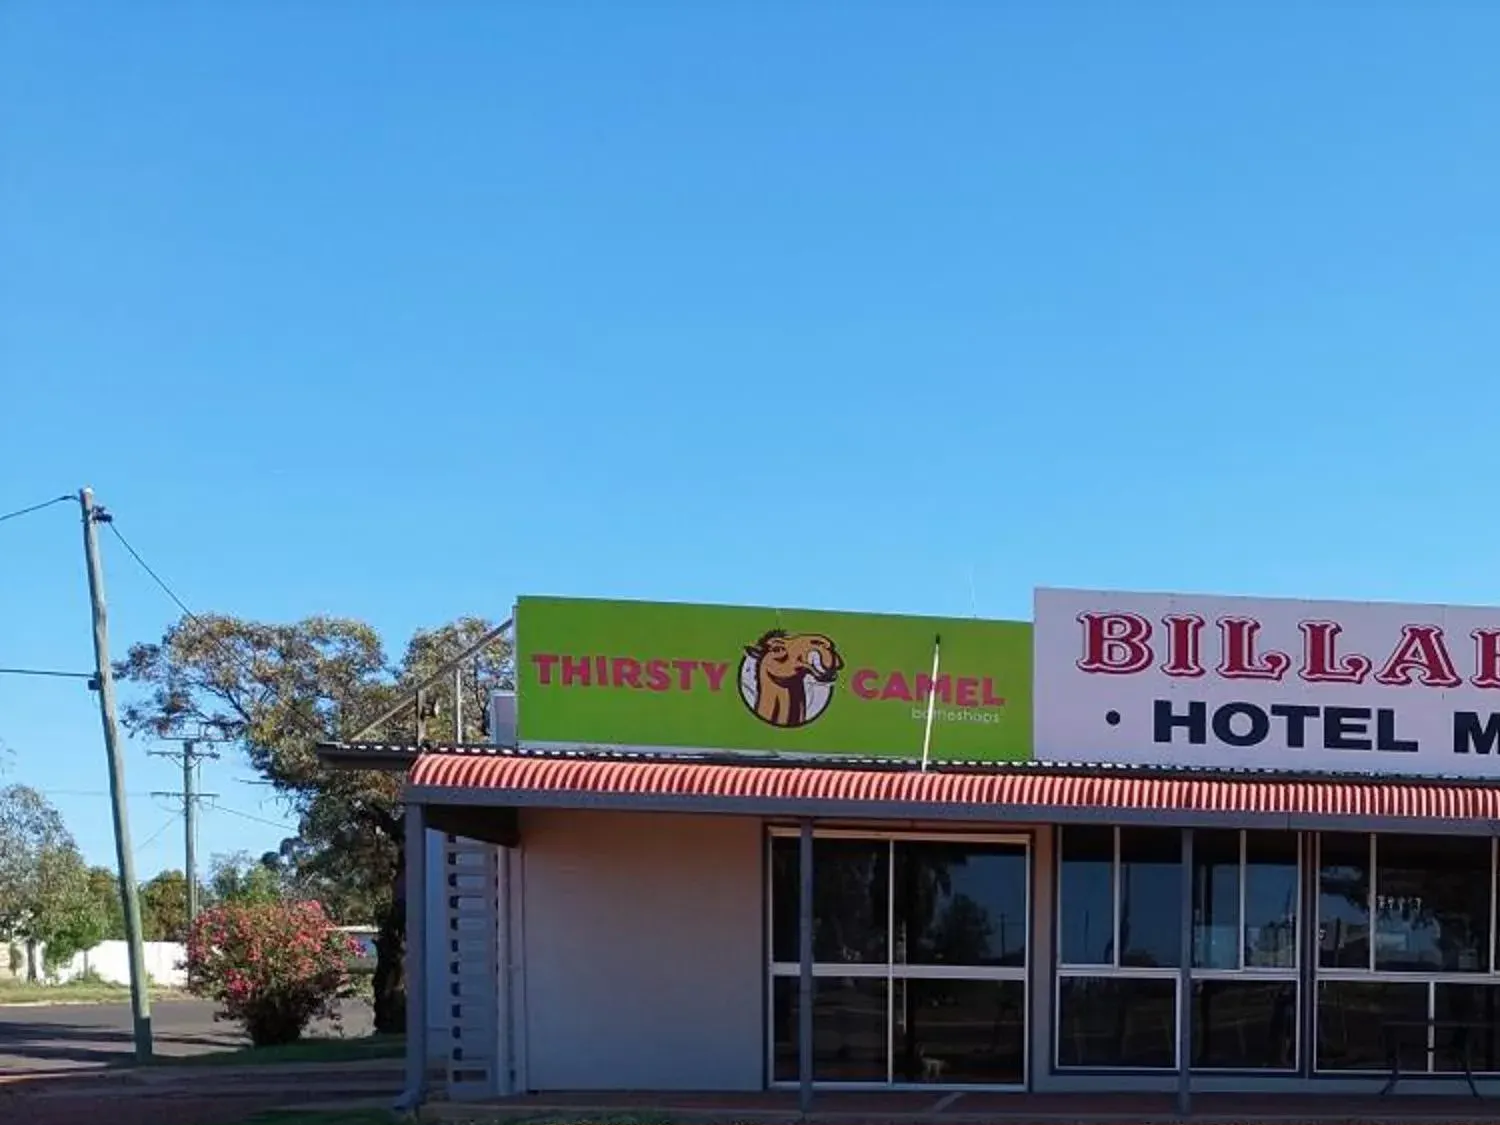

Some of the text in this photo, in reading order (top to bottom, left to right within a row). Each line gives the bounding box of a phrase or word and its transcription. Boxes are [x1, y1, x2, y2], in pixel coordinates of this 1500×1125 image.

[532, 653, 1006, 707] THIRSTY CAMEL
[1153, 699, 1419, 753] HOTEL
